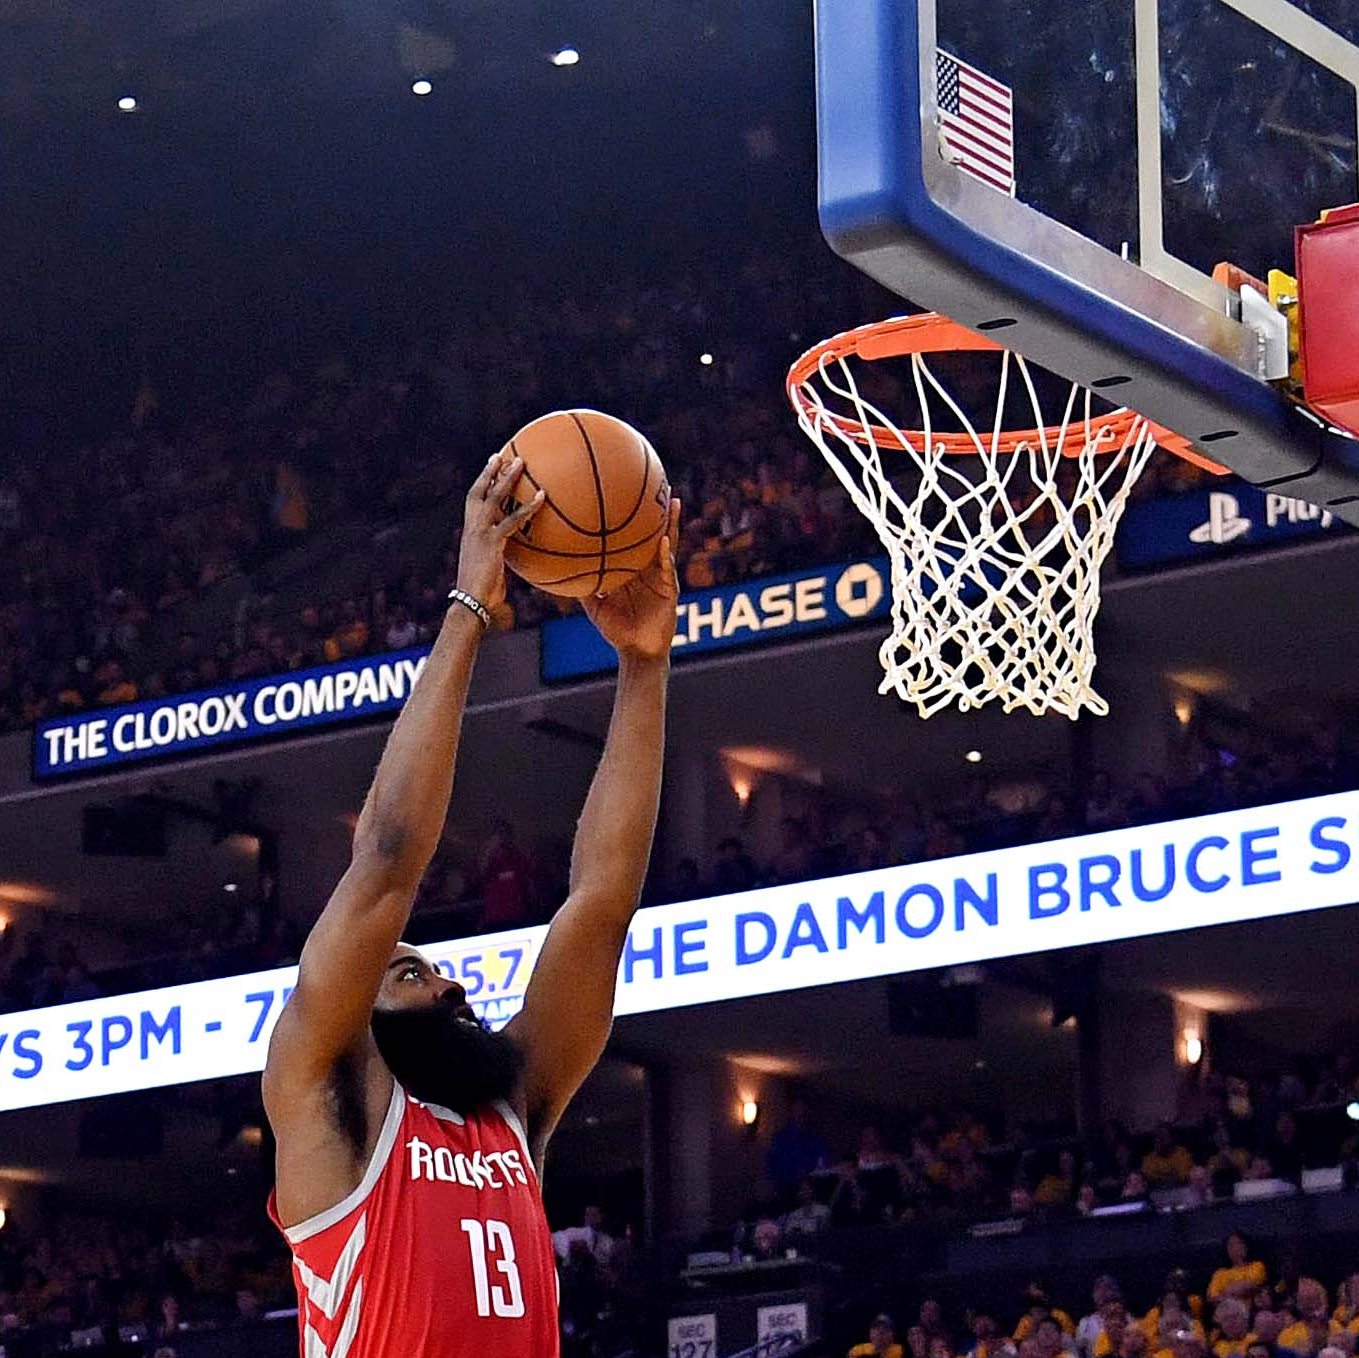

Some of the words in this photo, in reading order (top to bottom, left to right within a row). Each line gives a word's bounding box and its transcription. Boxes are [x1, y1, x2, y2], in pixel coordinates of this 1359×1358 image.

[43, 719, 108, 765] THE
[112, 693, 248, 752] CLOROX
[253, 655, 429, 725] COMPANY
[623, 919, 709, 984] HE
[734, 872, 999, 967] DAMON
[1027, 825, 1282, 921] BRUCE
[65, 1005, 182, 1072] 3PM
[460, 1219, 525, 1318] 13
